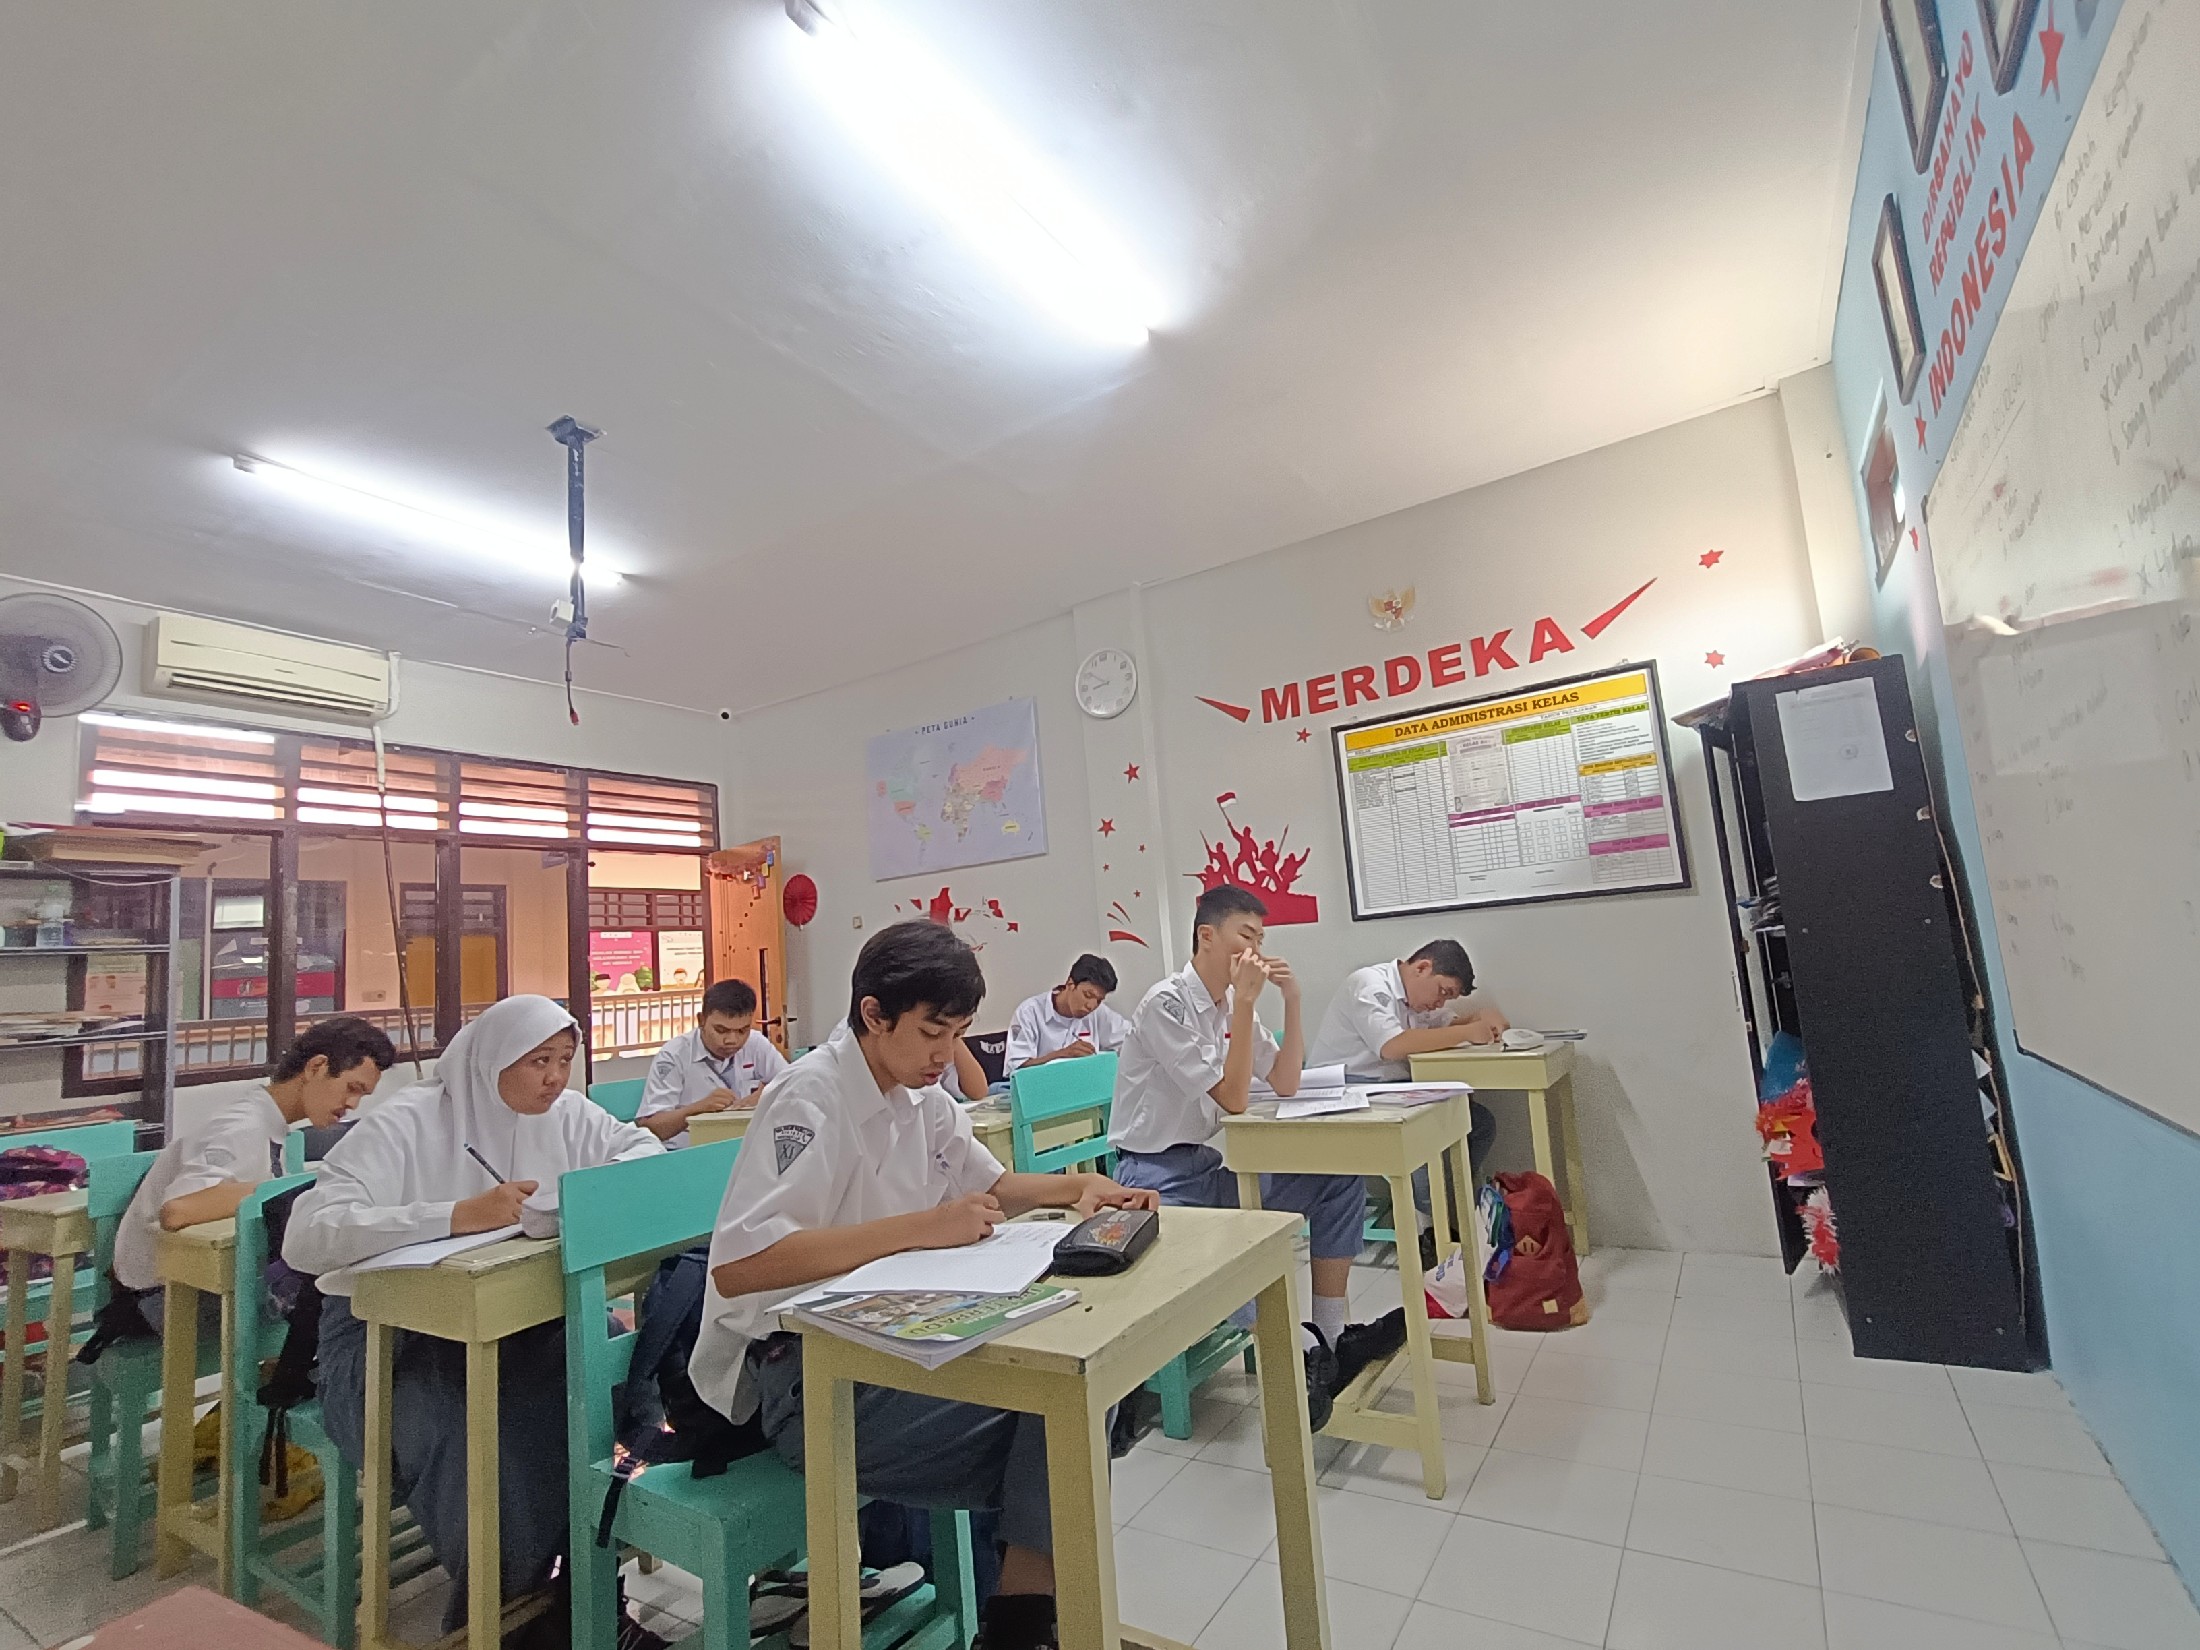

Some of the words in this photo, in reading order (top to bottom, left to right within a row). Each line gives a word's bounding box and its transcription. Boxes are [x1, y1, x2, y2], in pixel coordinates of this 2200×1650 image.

[1921, 30, 1974, 244] DIRGAHAYU
[1929, 92, 1986, 297] REPUBLIK
[1928, 112, 2035, 419] INDONESIA
[921, 724, 941, 735] PETA
[943, 716, 968, 730] DUNIA
[1261, 616, 1575, 723] MERDEKA
[1394, 721, 1429, 738] DATA
[1431, 702, 1528, 732] ADMINISTRASI
[1531, 691, 1580, 715] KELAS
